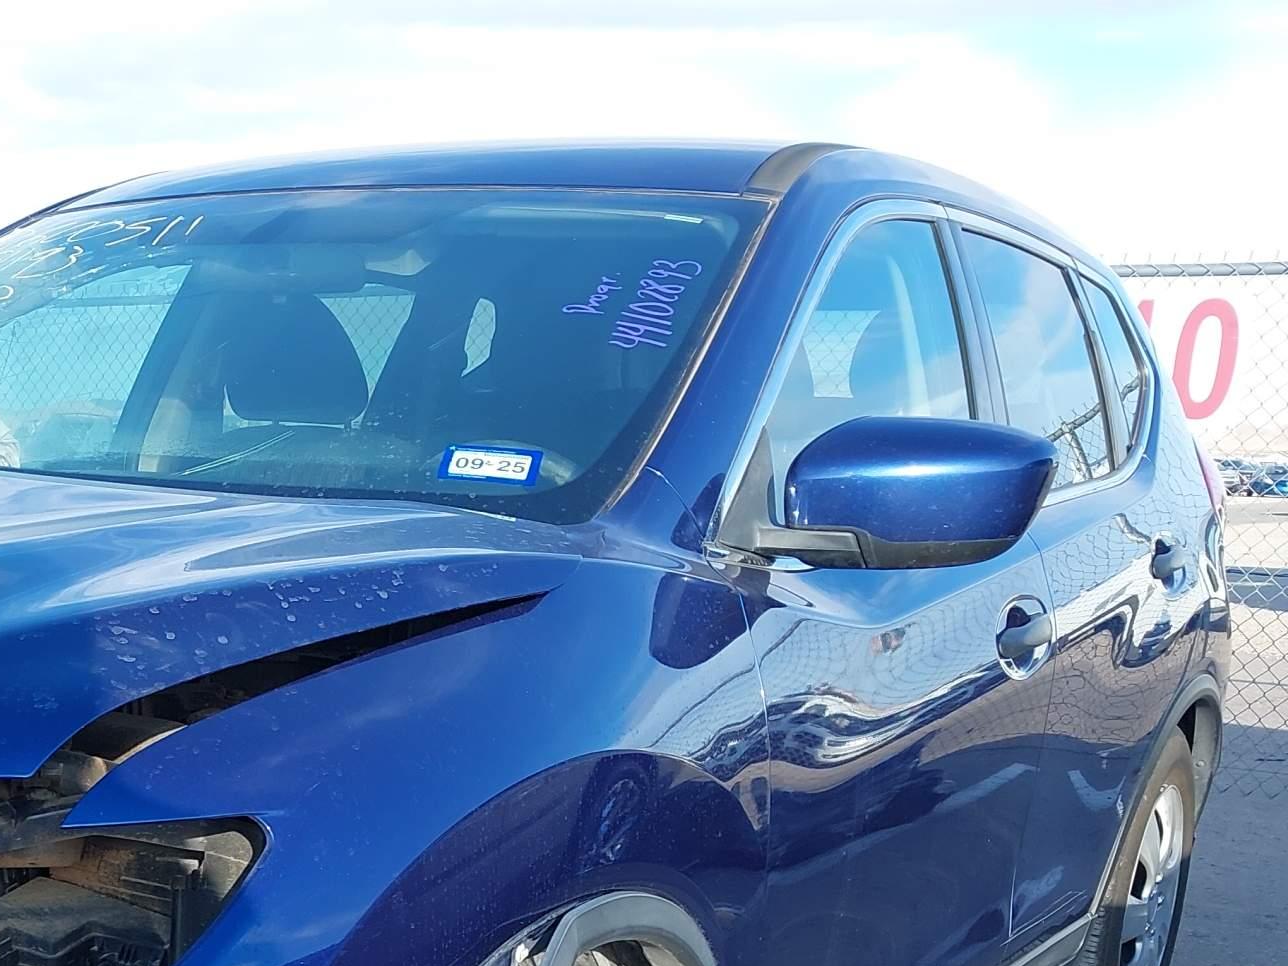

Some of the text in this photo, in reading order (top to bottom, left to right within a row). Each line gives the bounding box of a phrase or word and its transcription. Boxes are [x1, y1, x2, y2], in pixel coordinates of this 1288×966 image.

[608, 259, 702, 349] 44102893
[1137, 298, 1239, 420] 0
[455, 457, 527, 474] 09 25
